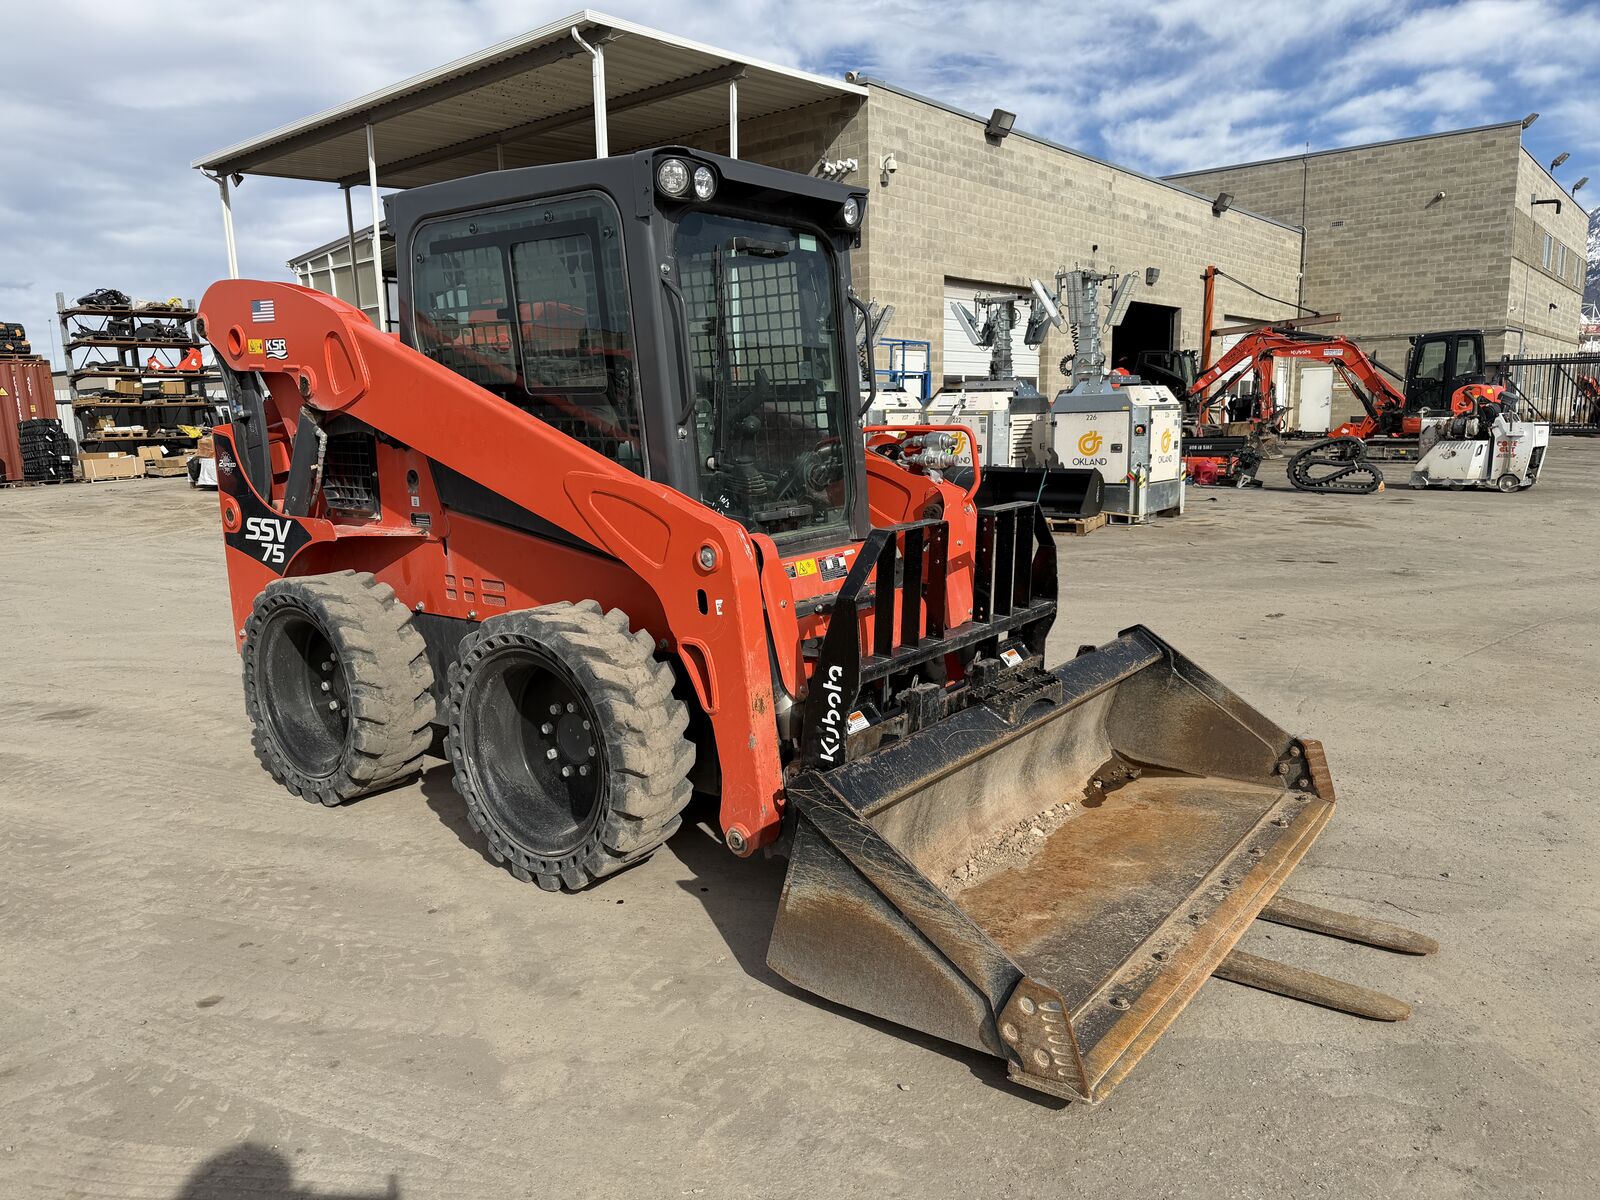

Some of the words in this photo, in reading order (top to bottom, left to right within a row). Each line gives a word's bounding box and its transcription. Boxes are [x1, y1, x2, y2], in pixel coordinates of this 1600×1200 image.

[266, 339, 286, 350] KSR
[1072, 457, 1107, 466] OKLAND
[245, 517, 292, 543] SSV
[260, 542, 285, 563] 75
[820, 665, 843, 762] Kubota
